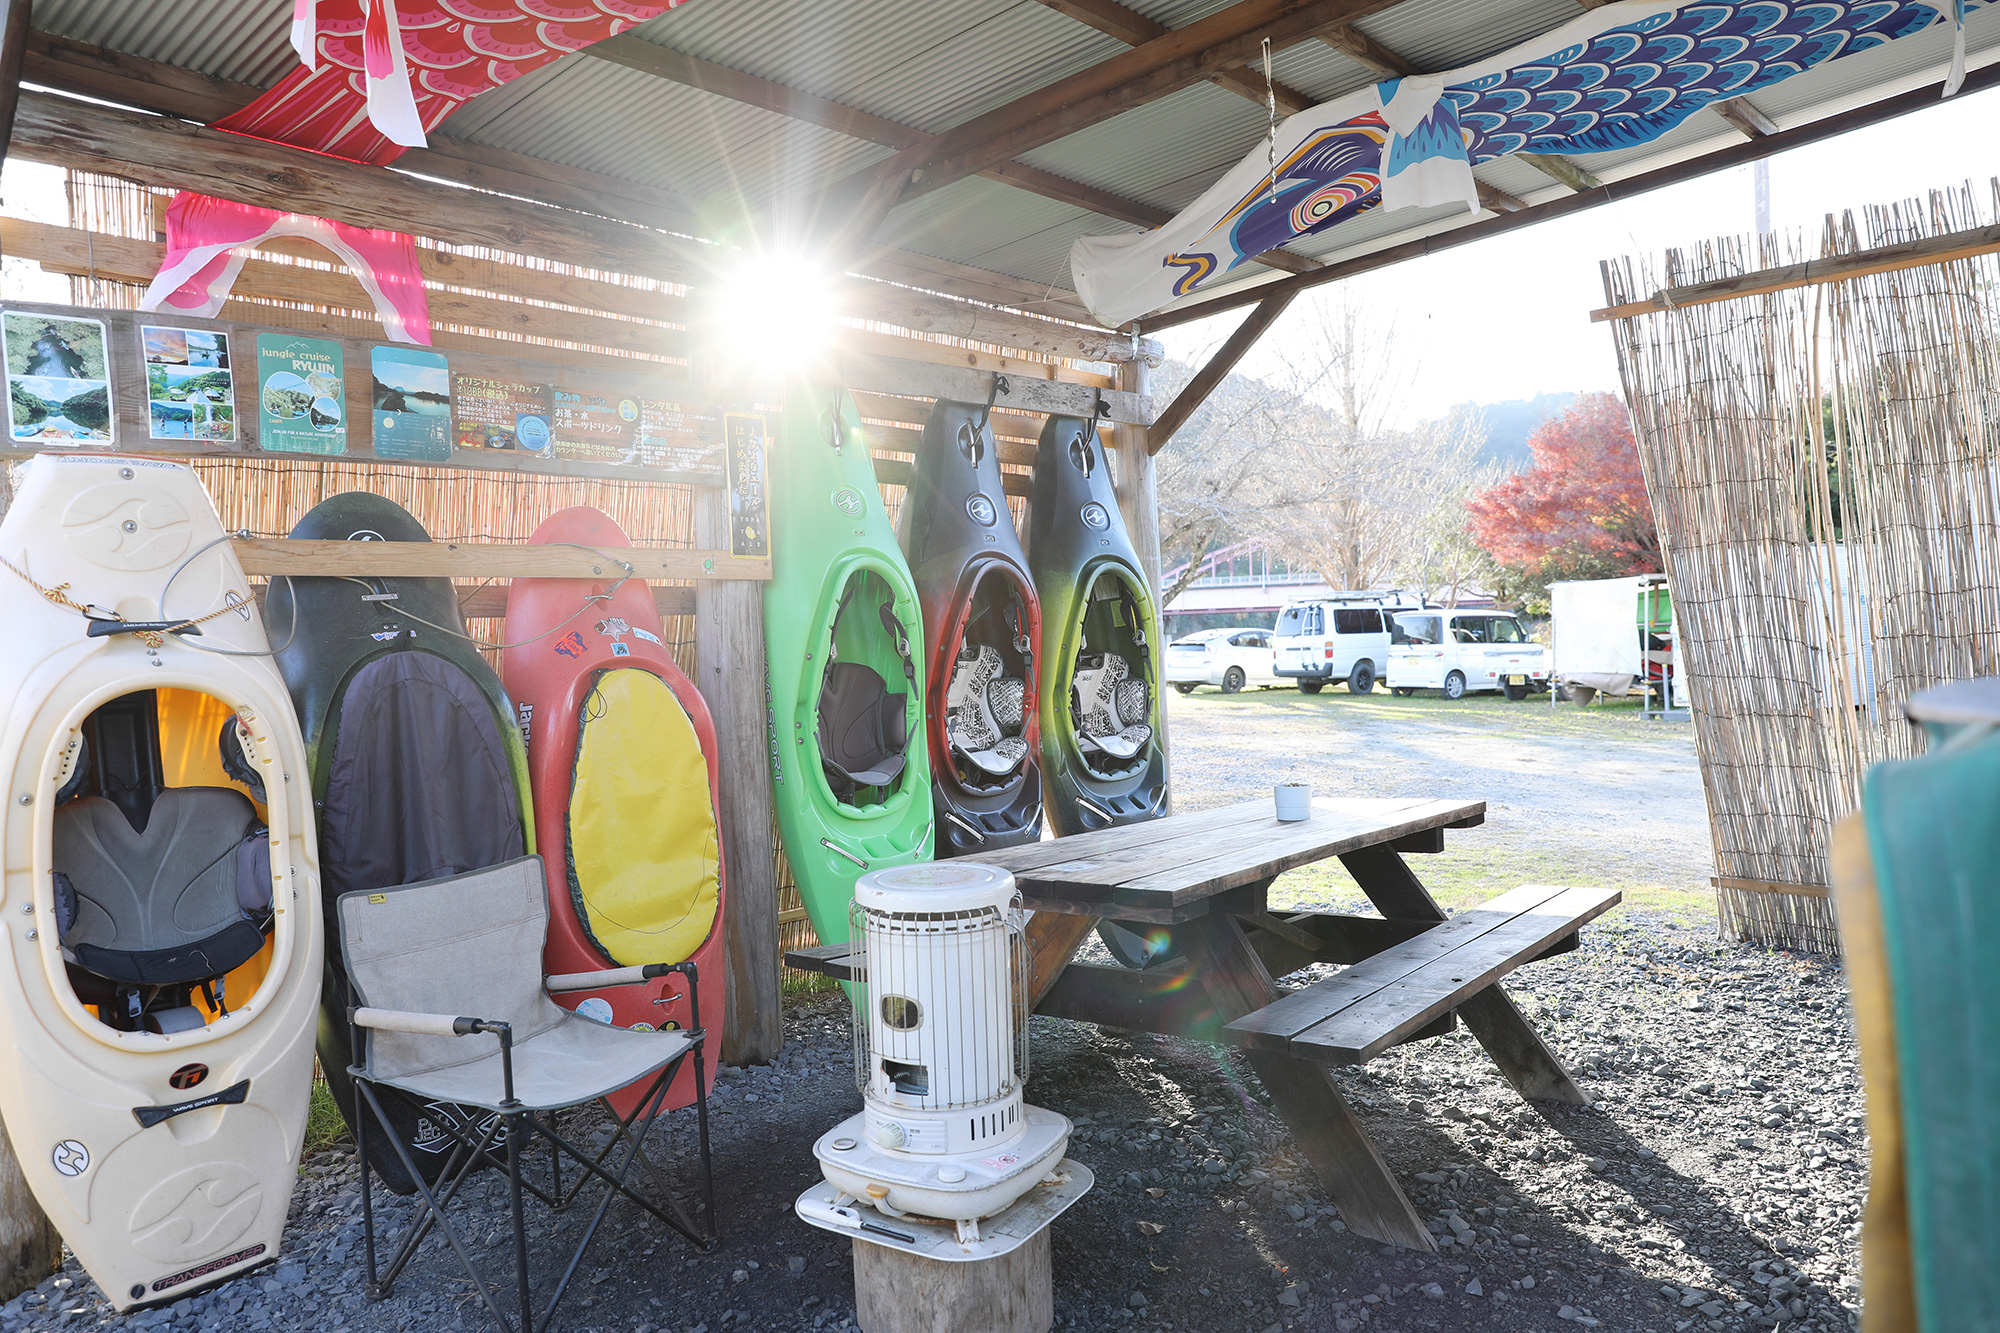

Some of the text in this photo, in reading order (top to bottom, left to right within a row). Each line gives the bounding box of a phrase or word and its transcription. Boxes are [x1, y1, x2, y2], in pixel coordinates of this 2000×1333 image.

[262, 347, 331, 362] jungle cruise
[292, 359, 335, 374] RYUJIN
[457, 376, 540, 394] オリジナルシェラカップ
[554, 391, 581, 403] 飲み物
[642, 399, 681, 412] レンタル品
[555, 408, 590, 420] お茶・水
[555, 418, 622, 435] スポーツドリンク
[748, 426, 761, 507] よなよなエール
[766, 706, 785, 785] SPORT
[172, 1096, 220, 1113] WAVE SPORT
[155, 1243, 265, 1291] TRANSFORMER
